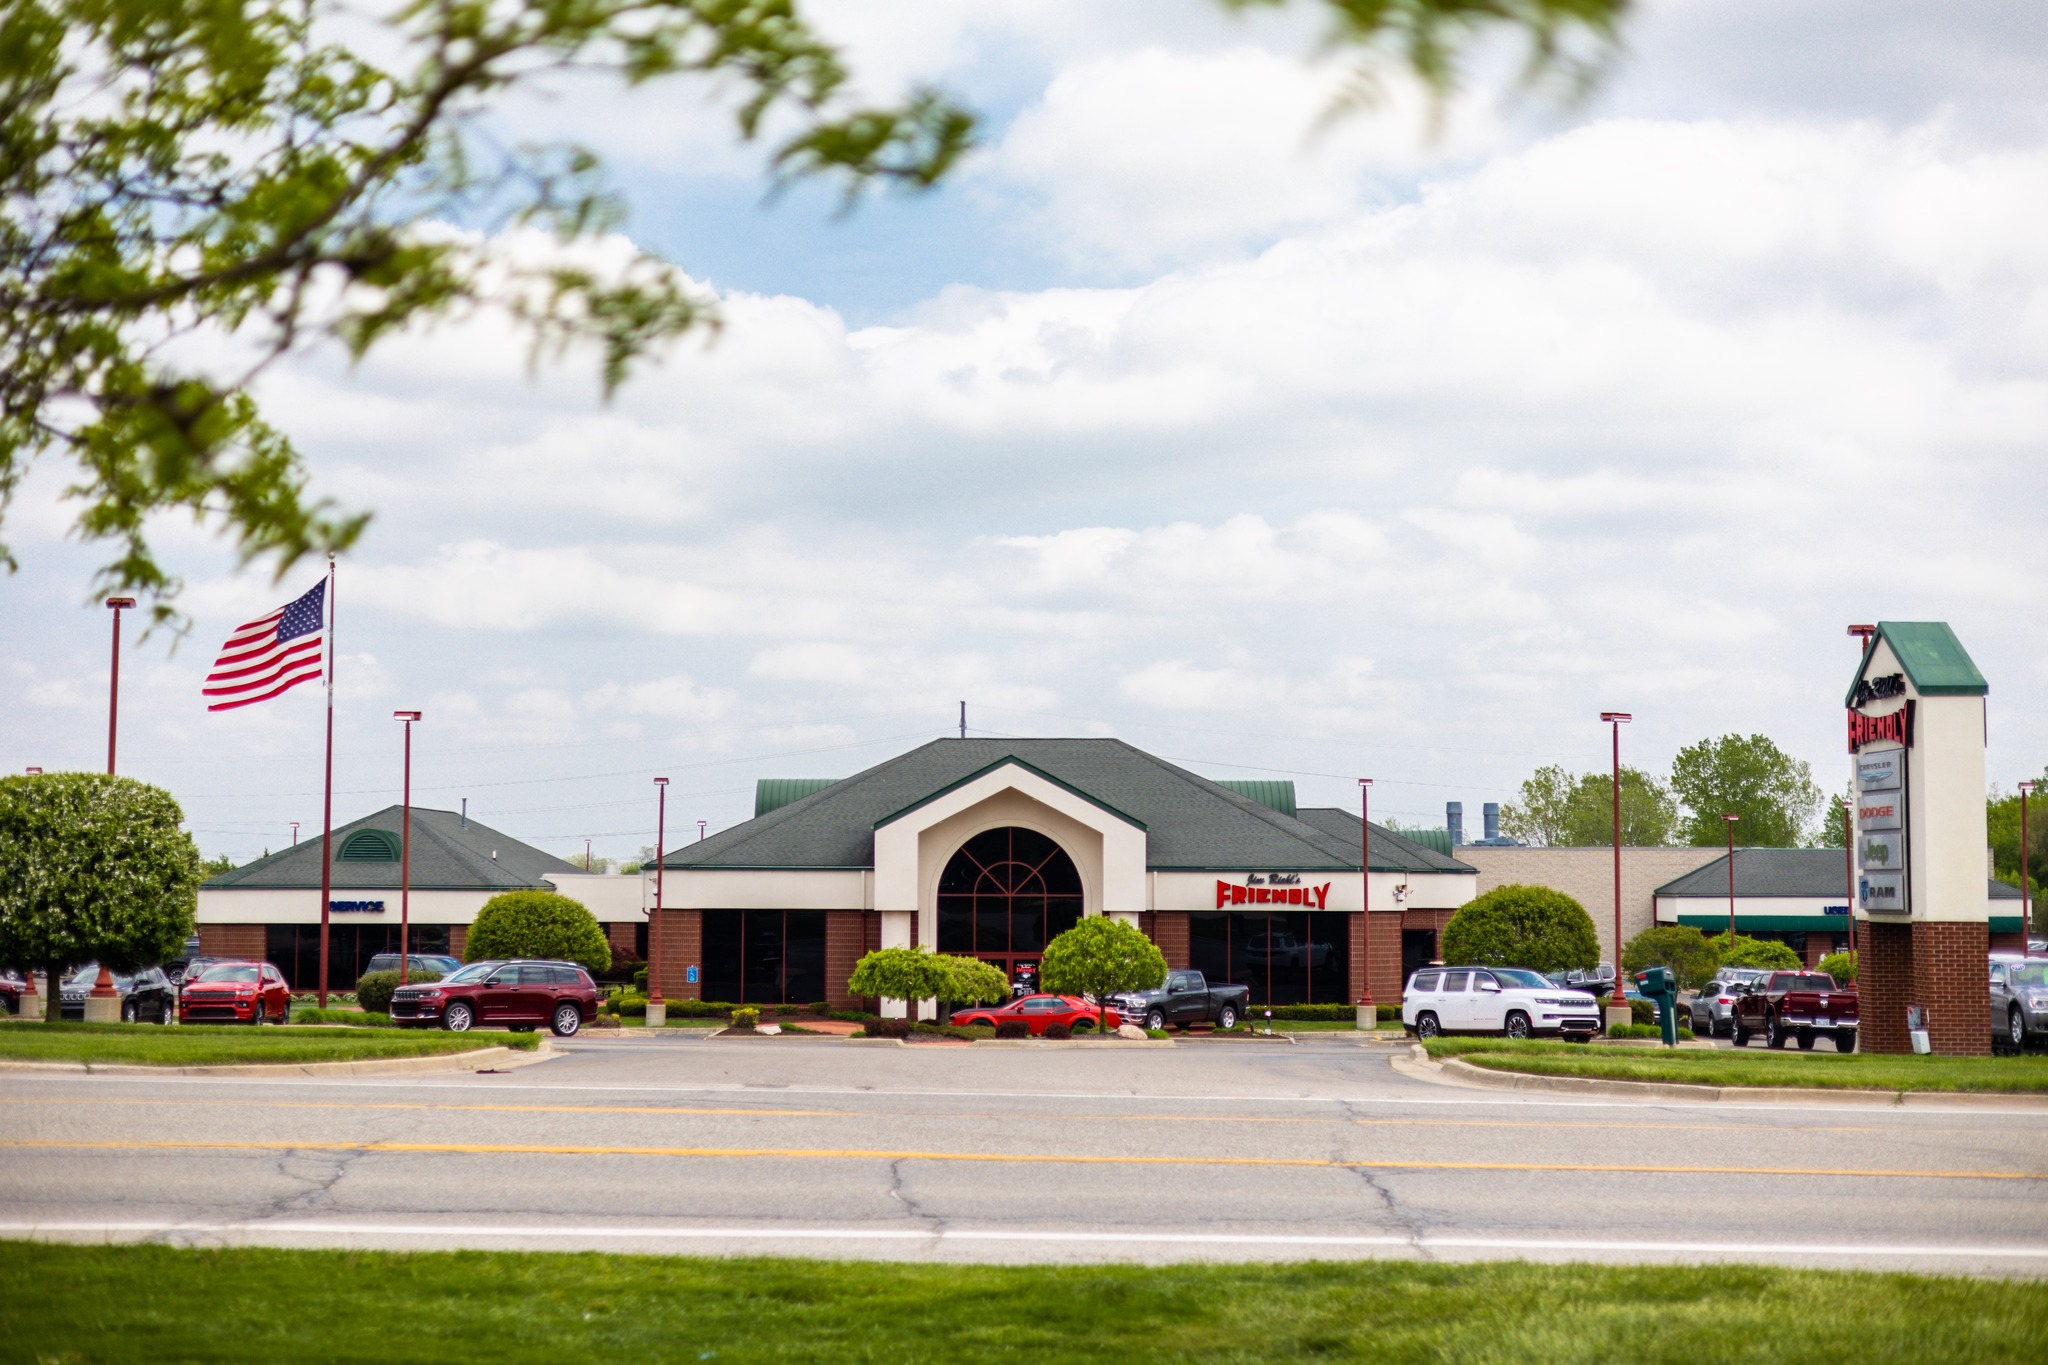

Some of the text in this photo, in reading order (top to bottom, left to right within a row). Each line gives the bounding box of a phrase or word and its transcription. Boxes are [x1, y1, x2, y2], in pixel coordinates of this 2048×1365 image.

[1848, 699, 1914, 754] FRIENDLY
[1859, 761, 1891, 771] CHRYSLER
[1859, 805, 1894, 819] DODGE
[1864, 839, 1889, 866] Jeep
[1216, 879, 1331, 910] FRIENDLY
[1869, 886, 1896, 898] RAM
[329, 900, 385, 912] SERVICE
